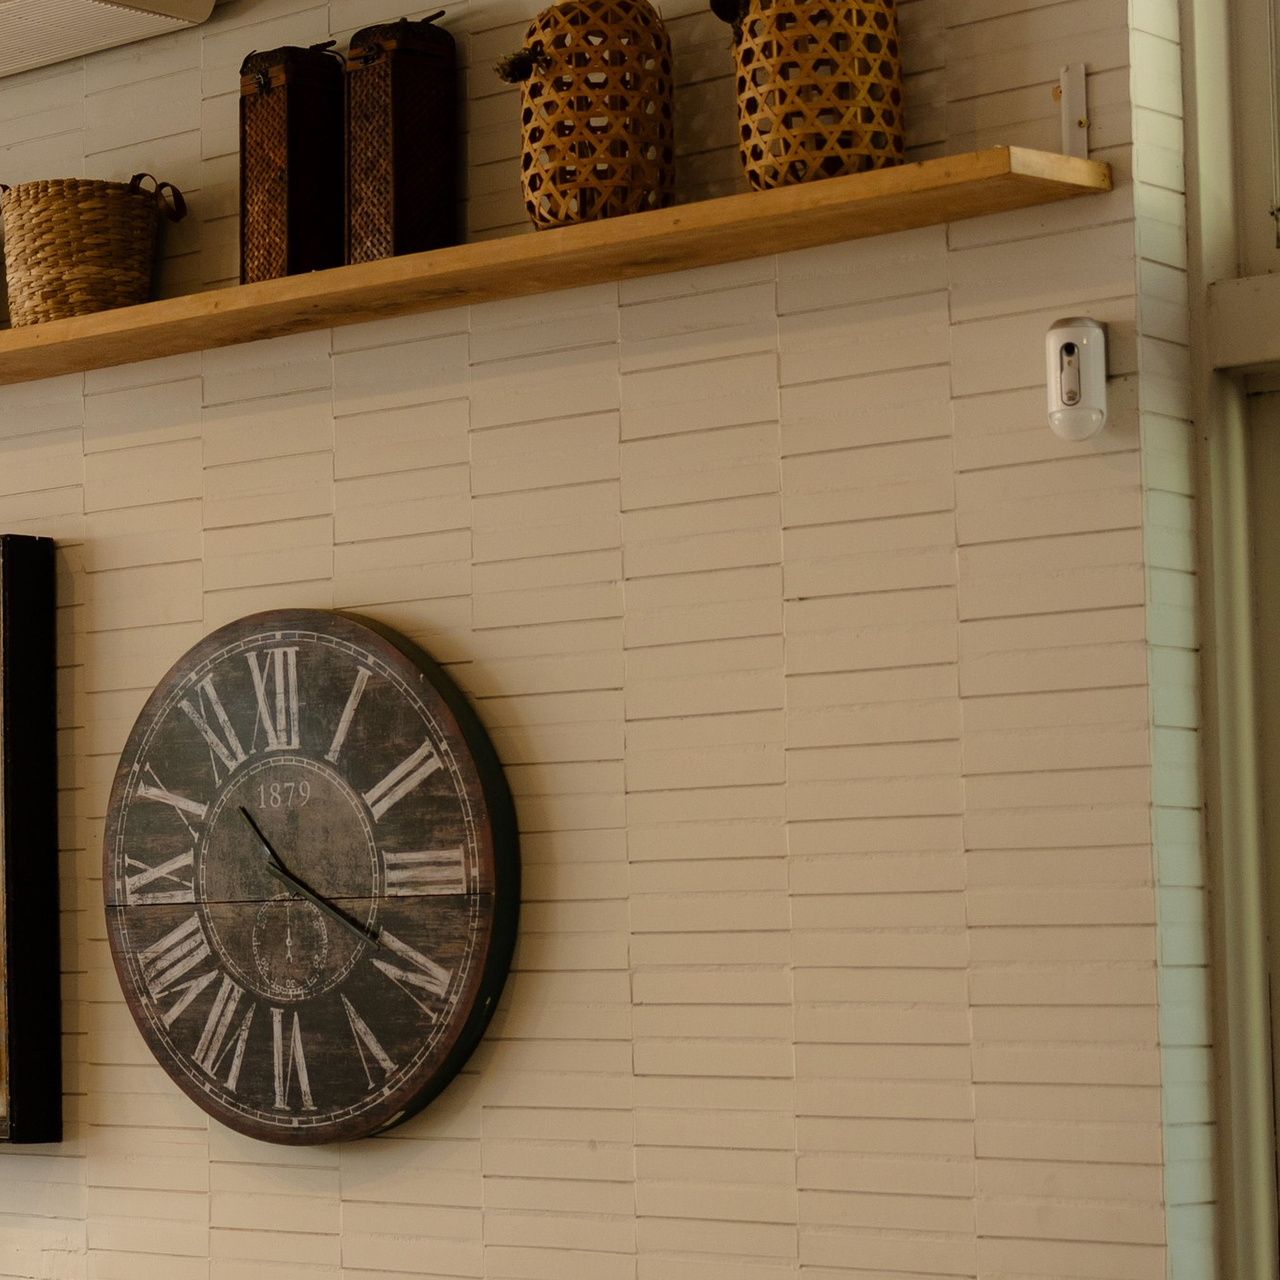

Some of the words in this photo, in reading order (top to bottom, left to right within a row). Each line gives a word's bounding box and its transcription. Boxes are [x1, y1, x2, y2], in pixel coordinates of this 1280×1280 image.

[178, 673, 249, 789] XI
[244, 646, 302, 754] XII
[136, 762, 209, 843] X
[257, 780, 311, 809] 1879
[361, 736, 444, 823] II
[382, 845, 466, 899] III
[271, 1007, 318, 1111] VI
